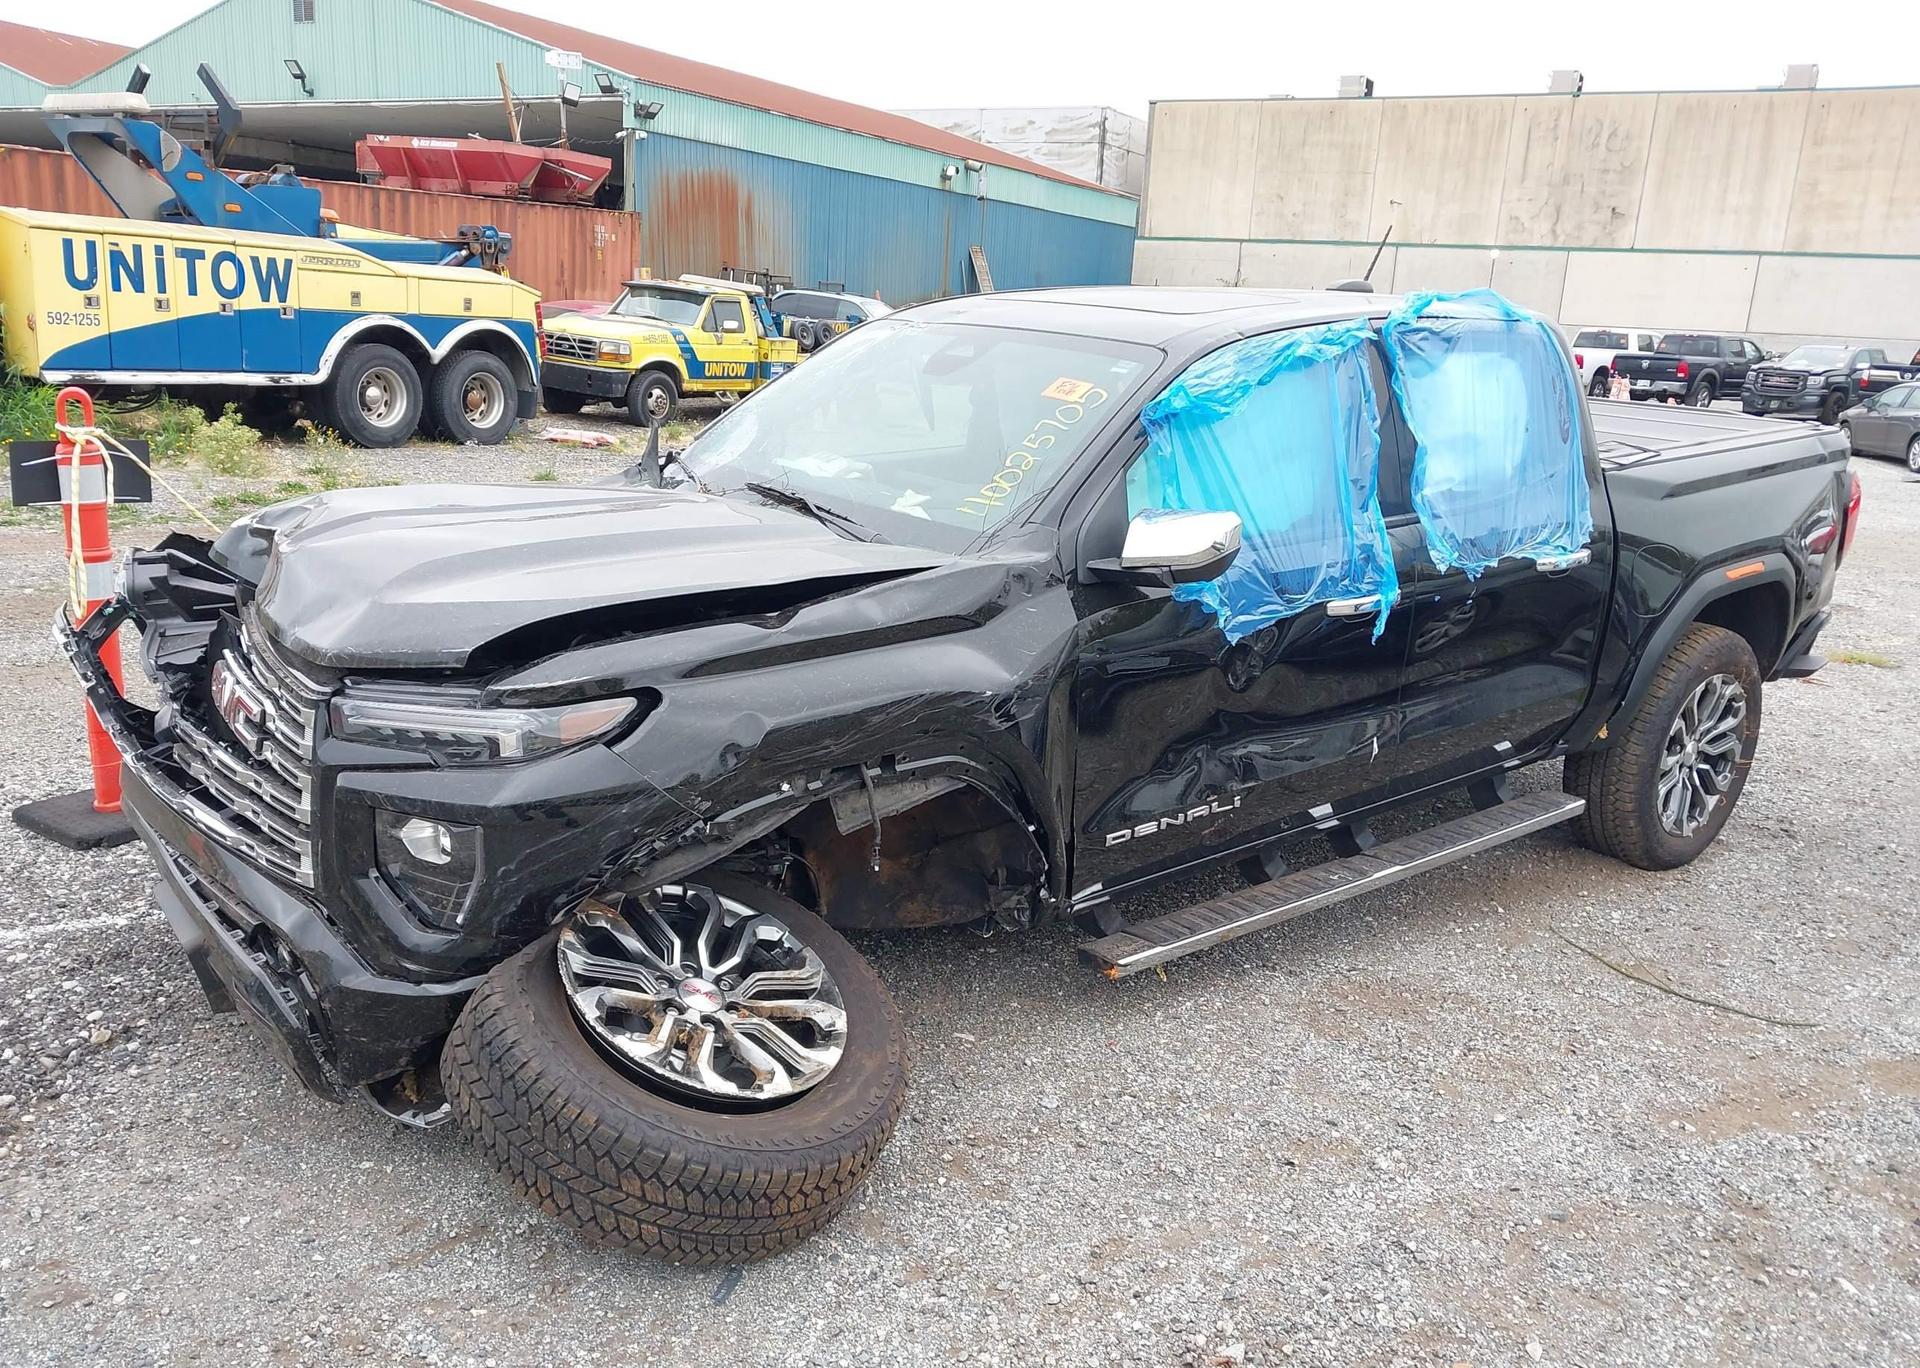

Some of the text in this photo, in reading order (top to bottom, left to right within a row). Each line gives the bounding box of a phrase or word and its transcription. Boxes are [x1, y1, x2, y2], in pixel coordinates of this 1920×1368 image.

[62, 237, 293, 304] UNITOW
[47, 311, 101, 326] 592-1255
[704, 362, 748, 377] UNITOW
[1105, 795, 1241, 847] DENALI
[682, 983, 720, 1002] GMC
